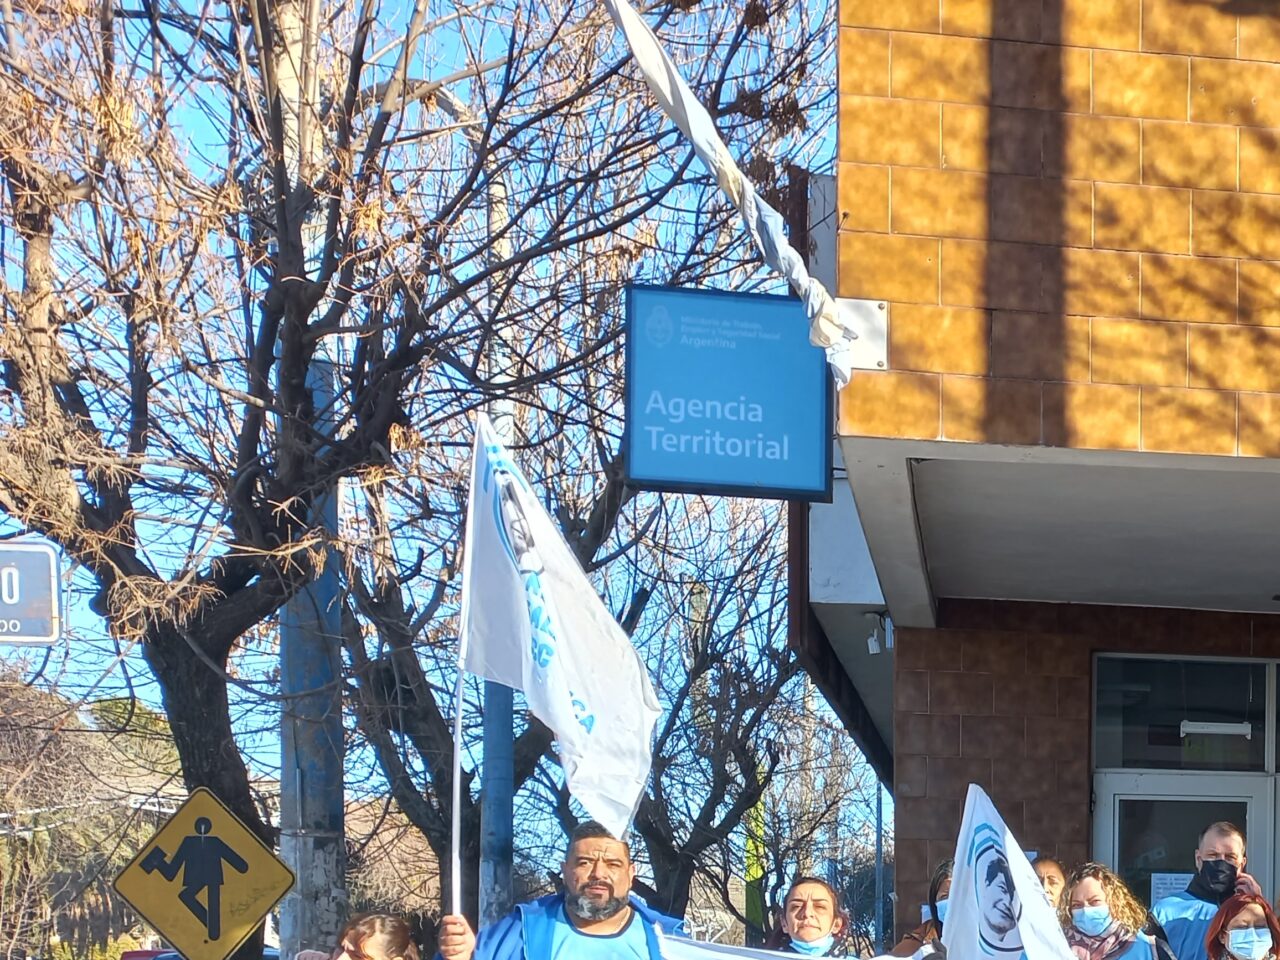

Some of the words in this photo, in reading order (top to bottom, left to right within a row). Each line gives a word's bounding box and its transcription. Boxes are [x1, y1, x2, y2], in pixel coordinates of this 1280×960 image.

[680, 334, 736, 349] Argentina
[645, 390, 763, 423] Agencia
[644, 426, 789, 461] Territorial
